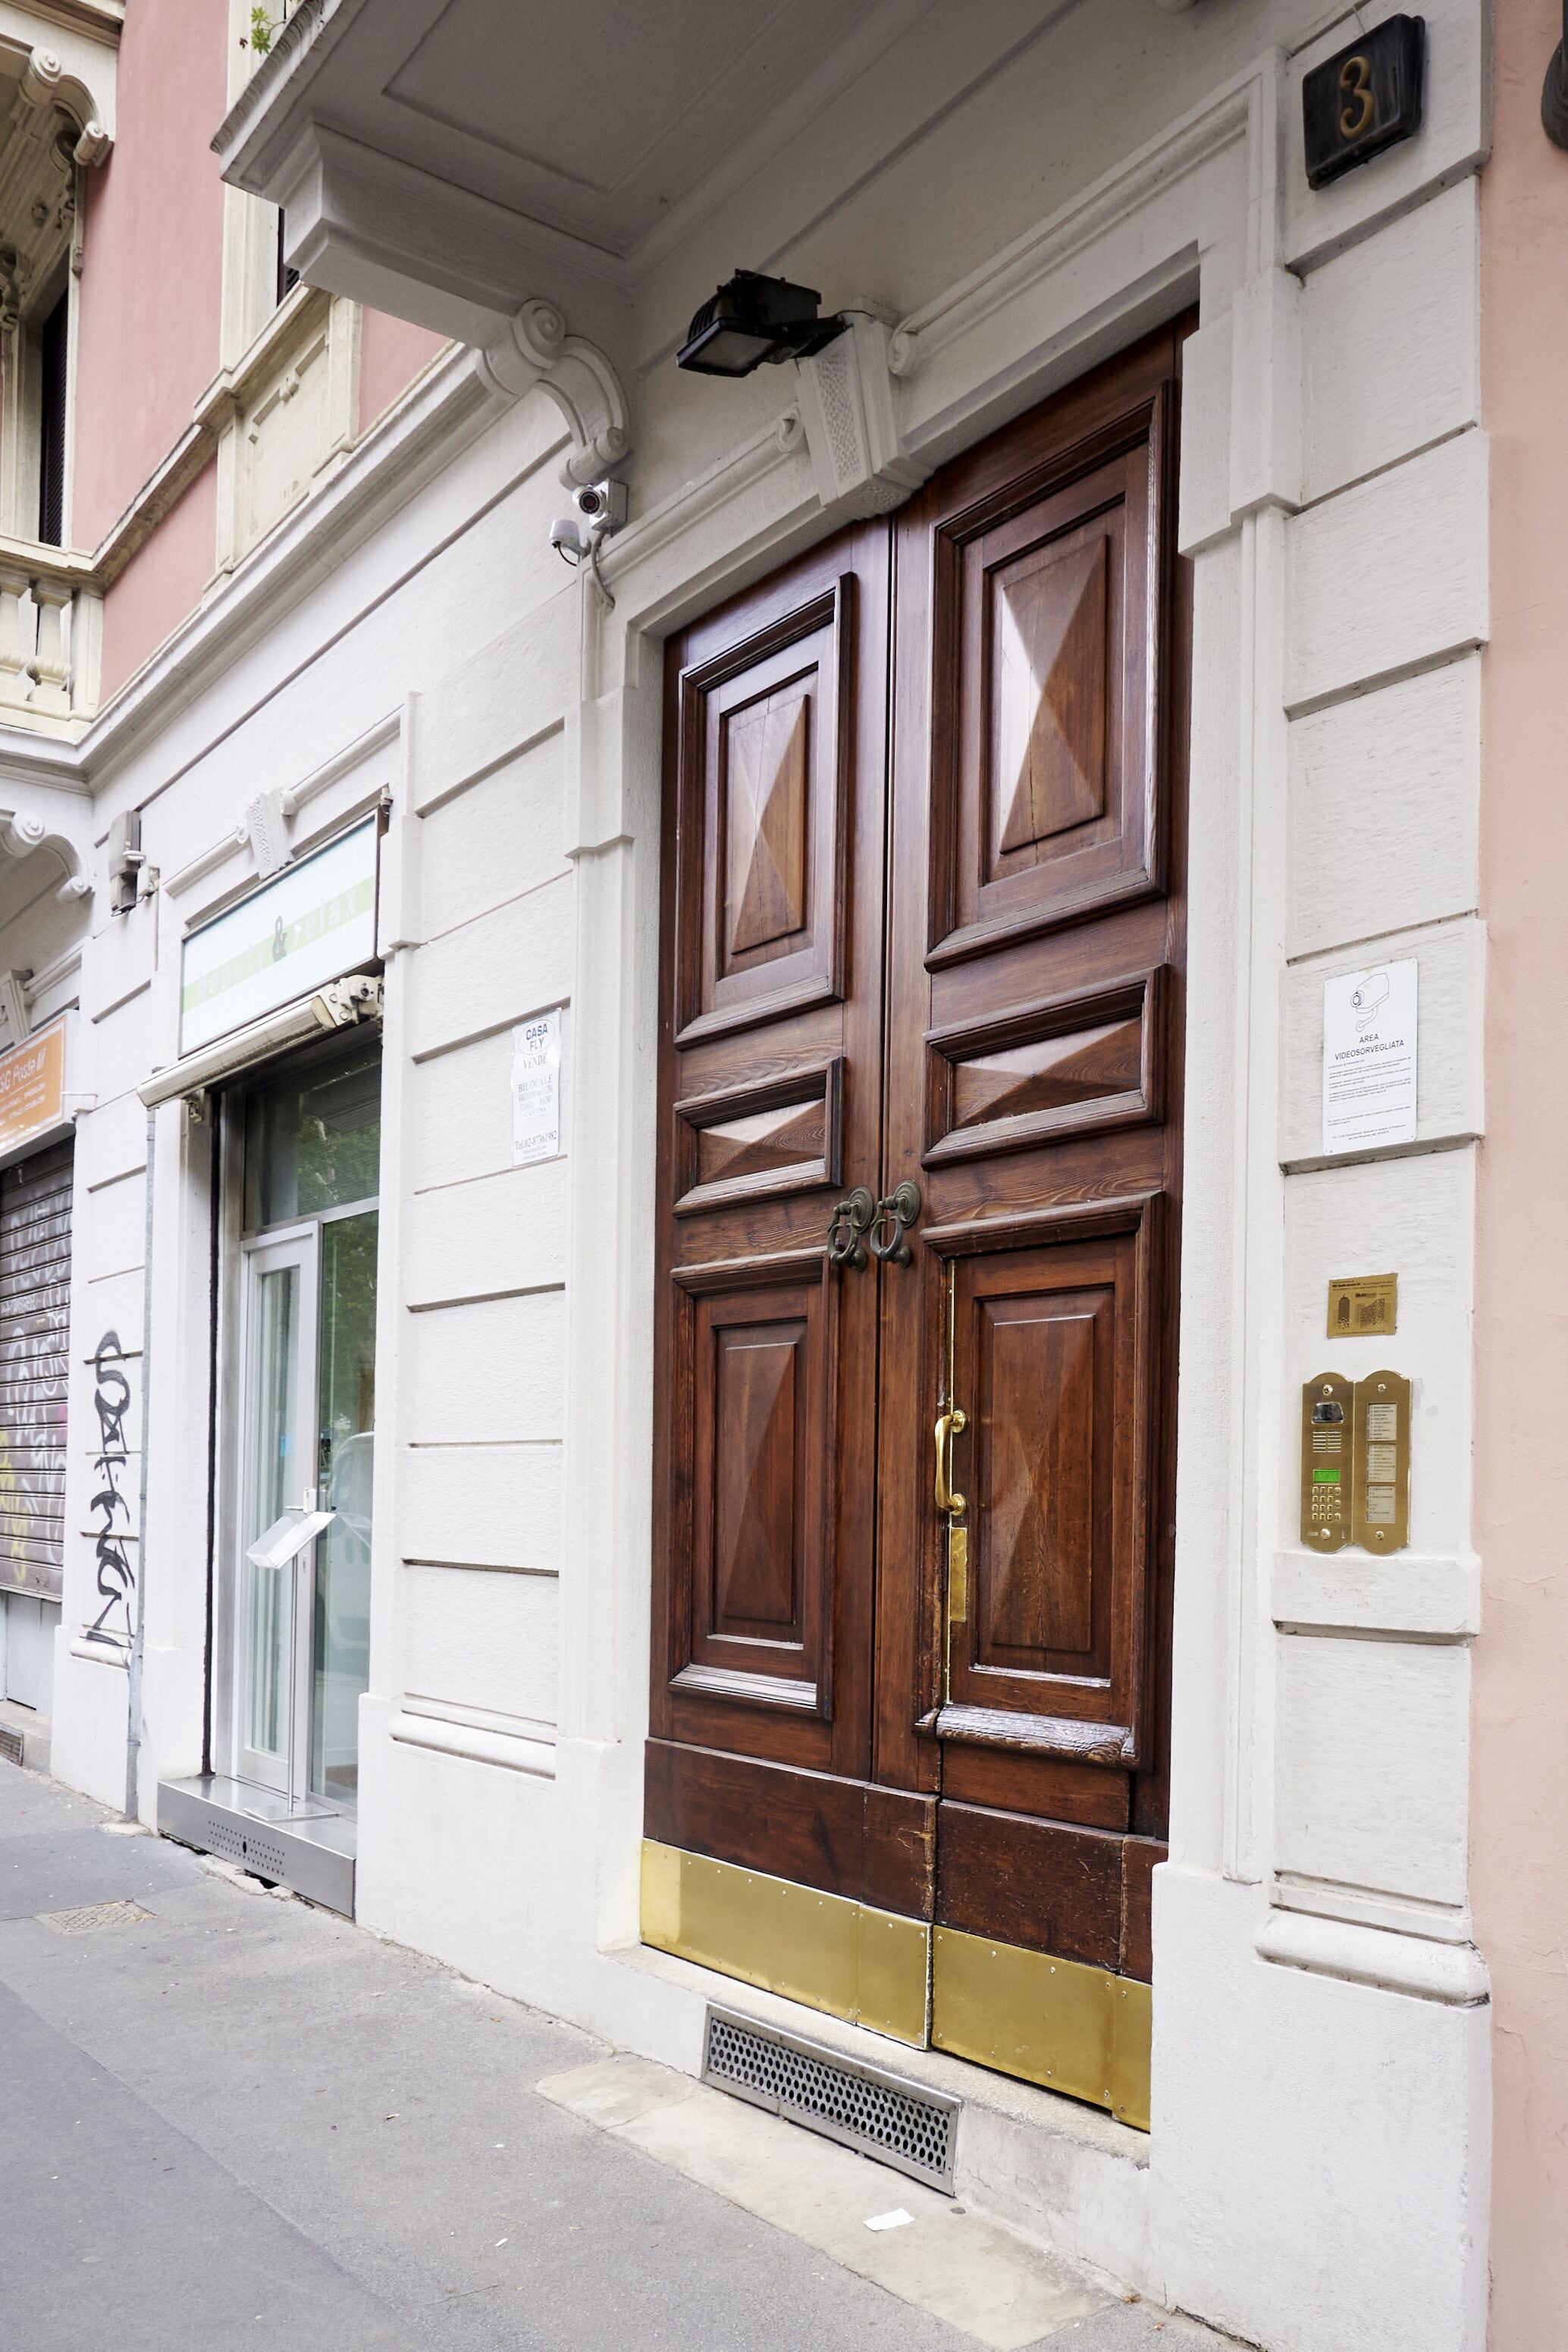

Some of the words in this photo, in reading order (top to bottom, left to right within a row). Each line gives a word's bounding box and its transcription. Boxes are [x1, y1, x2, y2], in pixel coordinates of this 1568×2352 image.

[1339, 55, 1375, 140] 3
[271, 915, 287, 962] &
[293, 890, 357, 947] relax
[525, 1023, 548, 1040] CASA
[1359, 1033, 1379, 1044] AREA
[529, 1036, 544, 1052] FLY
[1334, 1040, 1405, 1060] VIDEOSORVEGLIATA
[523, 1052, 547, 1069] VENDE
[518, 1074, 553, 1093] BILOCALE
